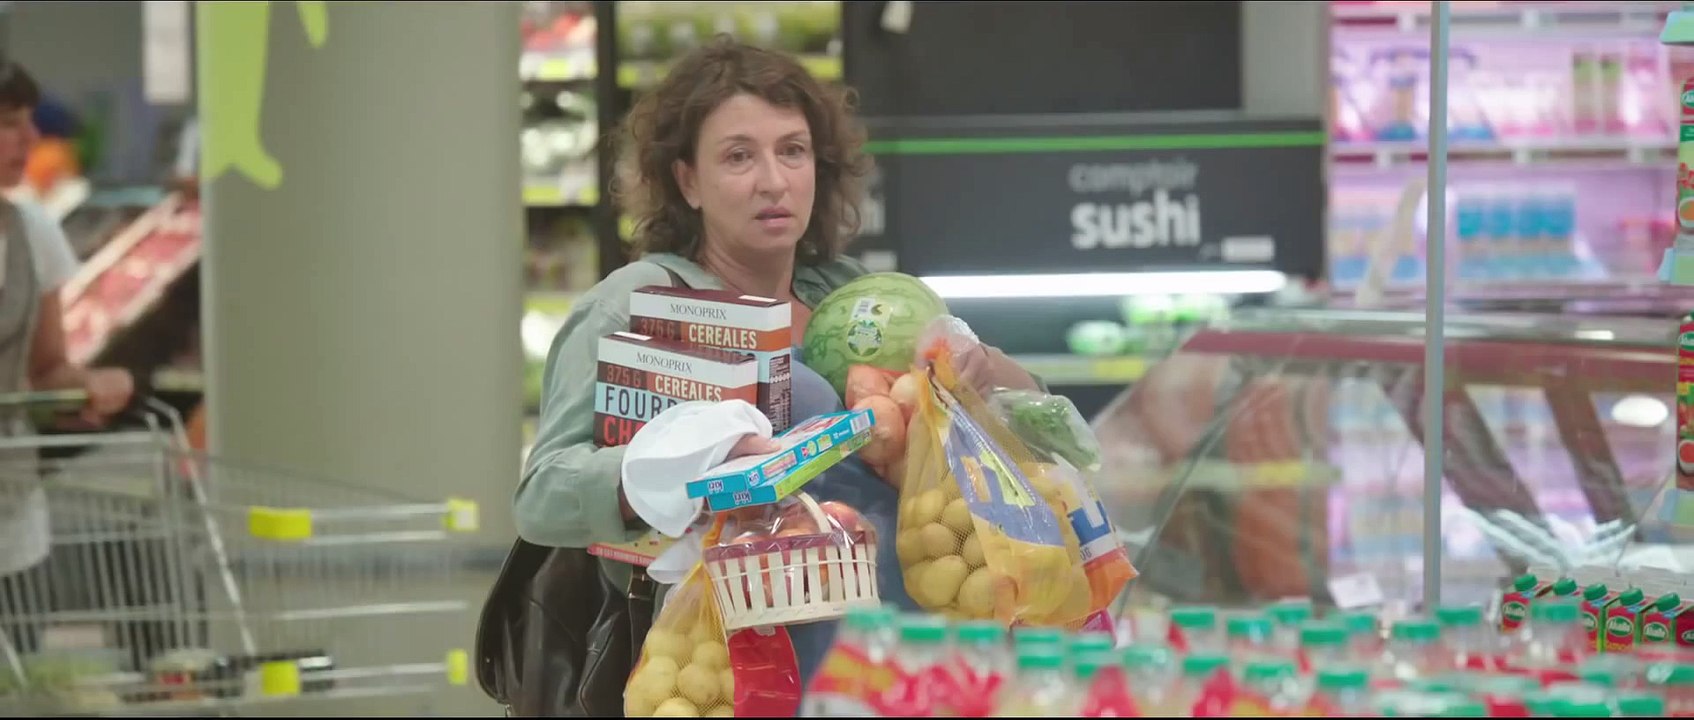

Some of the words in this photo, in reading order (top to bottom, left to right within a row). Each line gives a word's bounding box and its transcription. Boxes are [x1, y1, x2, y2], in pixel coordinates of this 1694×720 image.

[1068, 158, 1198, 193] comptoir
[1070, 189, 1201, 249] sushi
[670, 303, 727, 320] MONOPRIX
[688, 324, 757, 349] CEREALES
[636, 352, 693, 373] MONOPRIX
[607, 365, 629, 384] 375
[655, 375, 722, 402] CEREALES
[604, 416, 646, 445] CH
[708, 480, 724, 494] kiri
[733, 491, 752, 505] kiri
